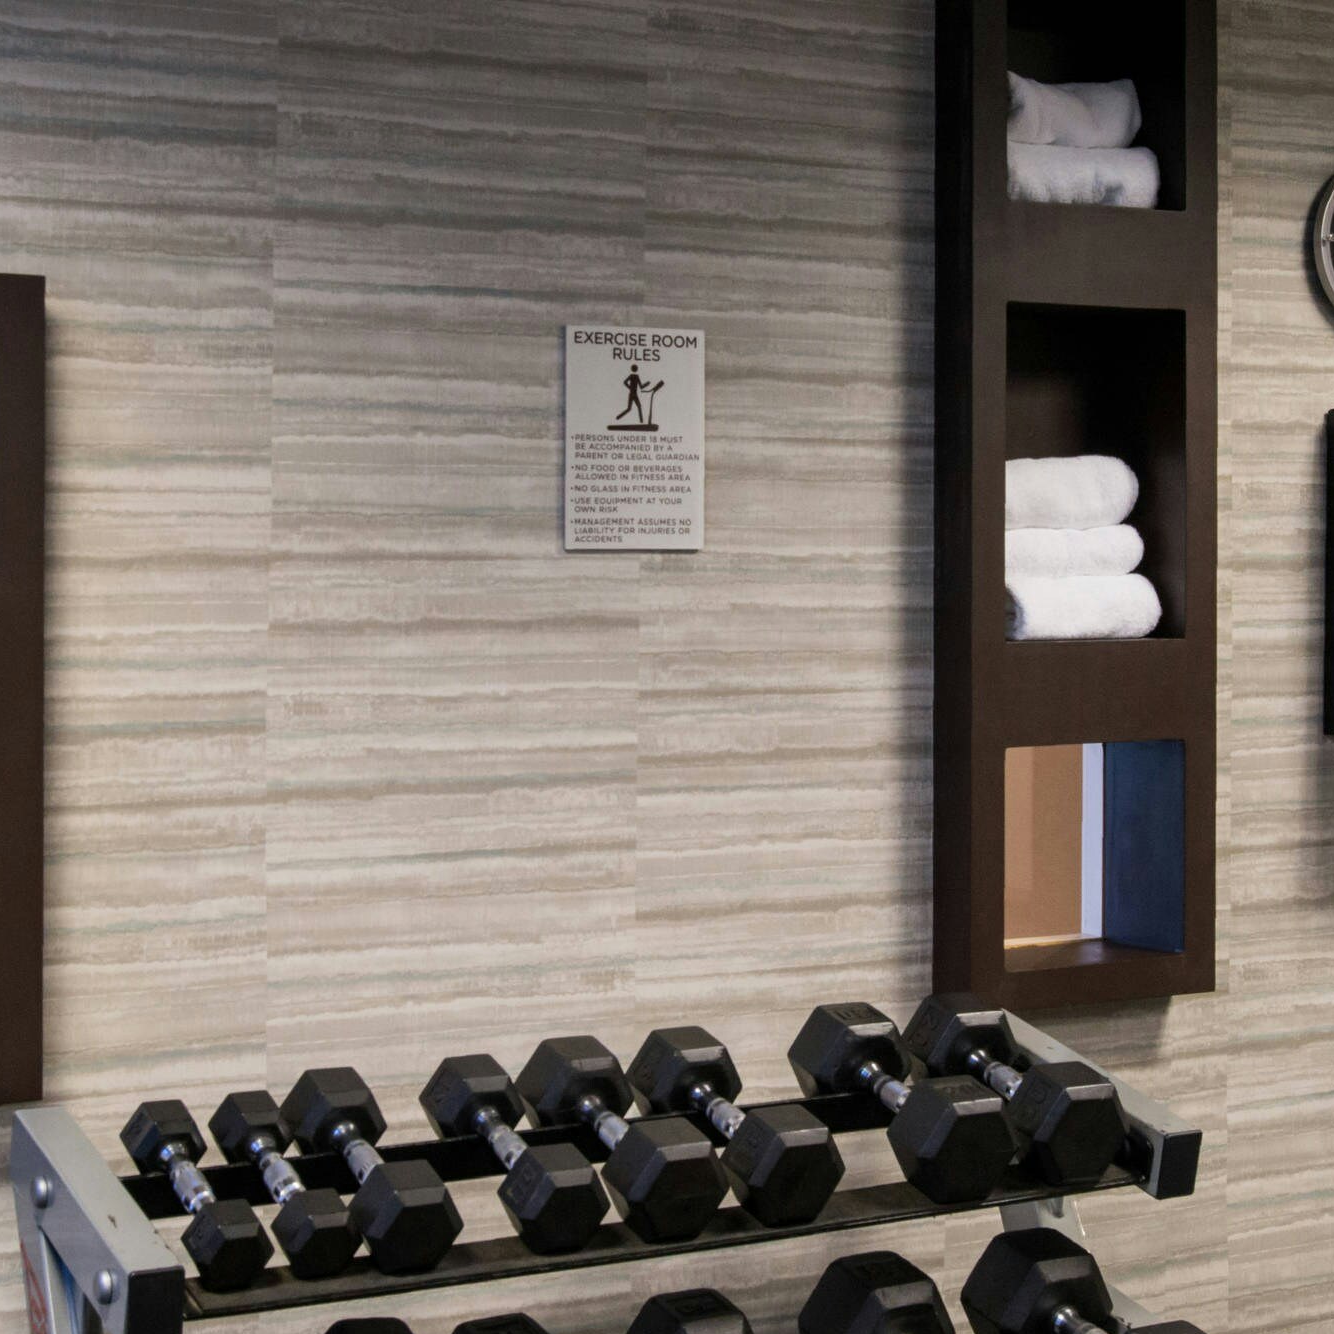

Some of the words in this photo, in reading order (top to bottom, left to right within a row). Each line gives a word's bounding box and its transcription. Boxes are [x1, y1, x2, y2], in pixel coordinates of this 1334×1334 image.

[574, 331, 647, 347] EXERCISE
[652, 334, 697, 348] ROOM
[613, 347, 661, 361] RULES
[575, 434, 615, 442] PERSONS
[589, 443, 651, 452] ACCOMPANIED
[575, 452, 608, 460] PARENT
[611, 452, 623, 460] OR
[655, 453, 700, 461] GUARDIAN
[575, 464, 587, 472] NO
[591, 464, 615, 472] FOOD
[631, 473, 666, 481] FITNESS
[590, 485, 618, 493] GLASS
[621, 485, 630, 493] IN
[632, 485, 666, 493] FITNESS
[594, 497, 643, 505] EQUIPMENT
[646, 497, 656, 505] AT
[659, 497, 682, 505] YOUR
[574, 518, 635, 526] MANAGEMENT
[637, 518, 677, 526] ASSUMES
[638, 527, 676, 535] INJURIES
